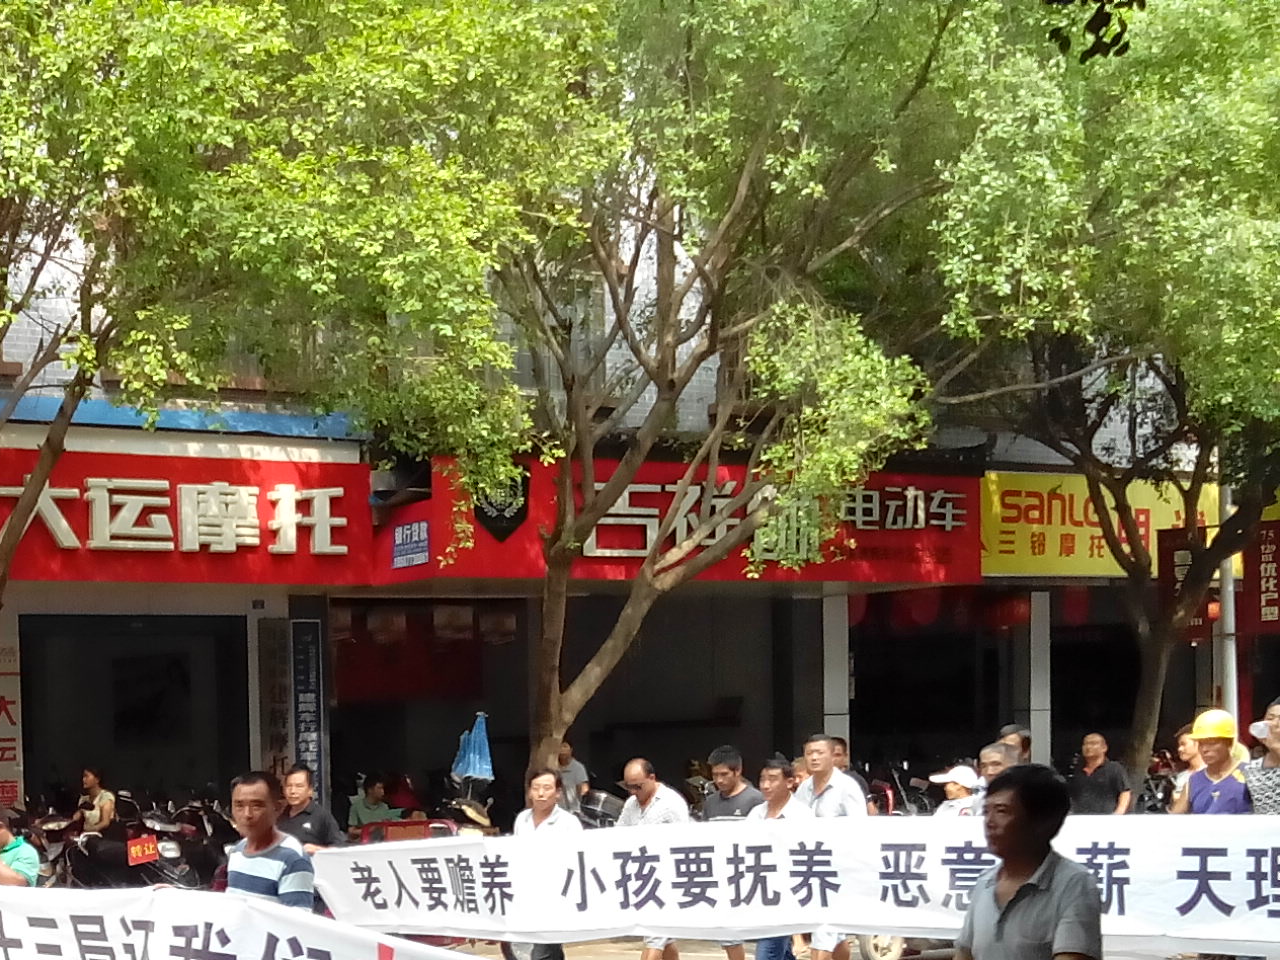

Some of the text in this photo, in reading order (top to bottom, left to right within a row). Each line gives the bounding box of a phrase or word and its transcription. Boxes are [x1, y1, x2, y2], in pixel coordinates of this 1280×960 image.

[841, 485, 968, 531] 电动车
[999, 530, 1106, 558] 三铃摩托
[350, 854, 514, 916] 老人要赡养
[561, 841, 841, 911] 小孩要抚养
[879, 841, 1130, 916] 恶意薪
